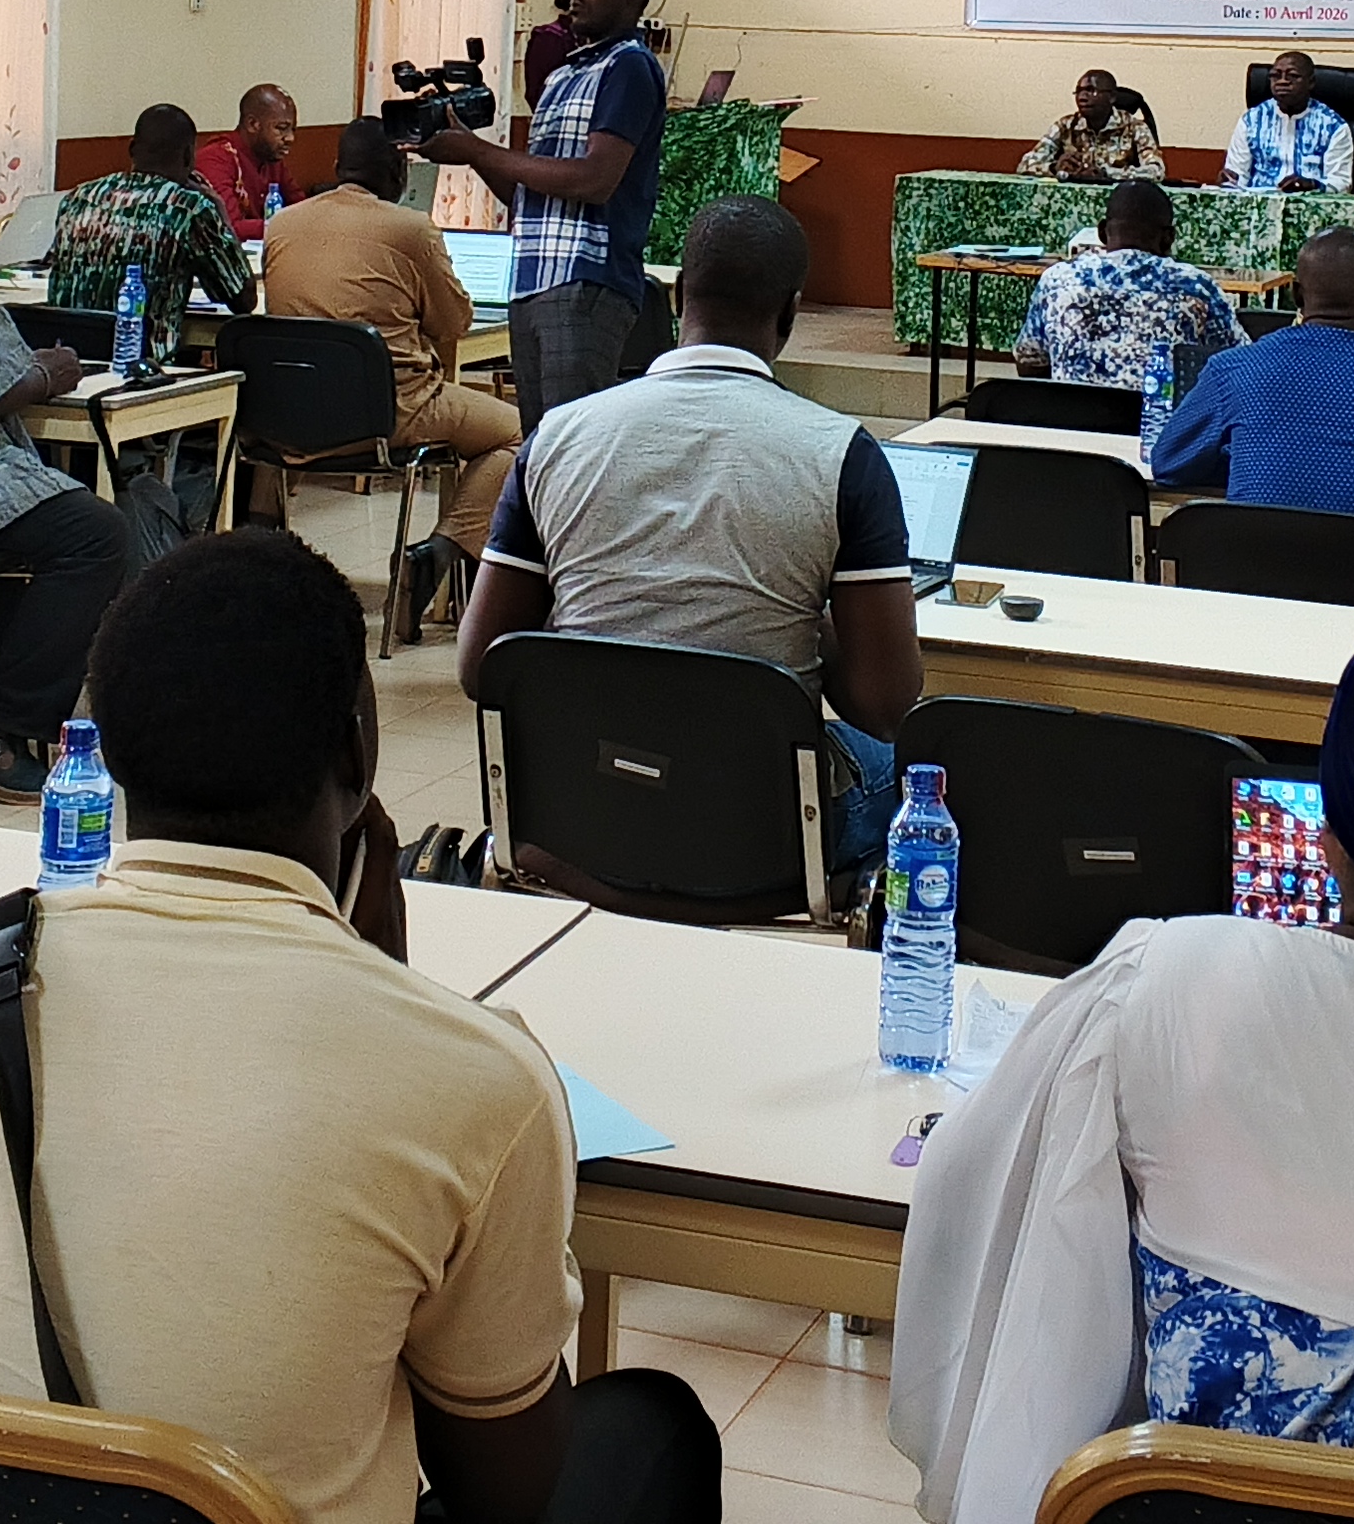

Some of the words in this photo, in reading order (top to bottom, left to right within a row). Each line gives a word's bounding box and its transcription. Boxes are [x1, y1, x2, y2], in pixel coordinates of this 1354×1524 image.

[1223, 4, 1253, 19] Date
[1263, 6, 1278, 19] 10
[1280, 6, 1313, 20] Avril
[1316, 7, 1349, 20] 2026
